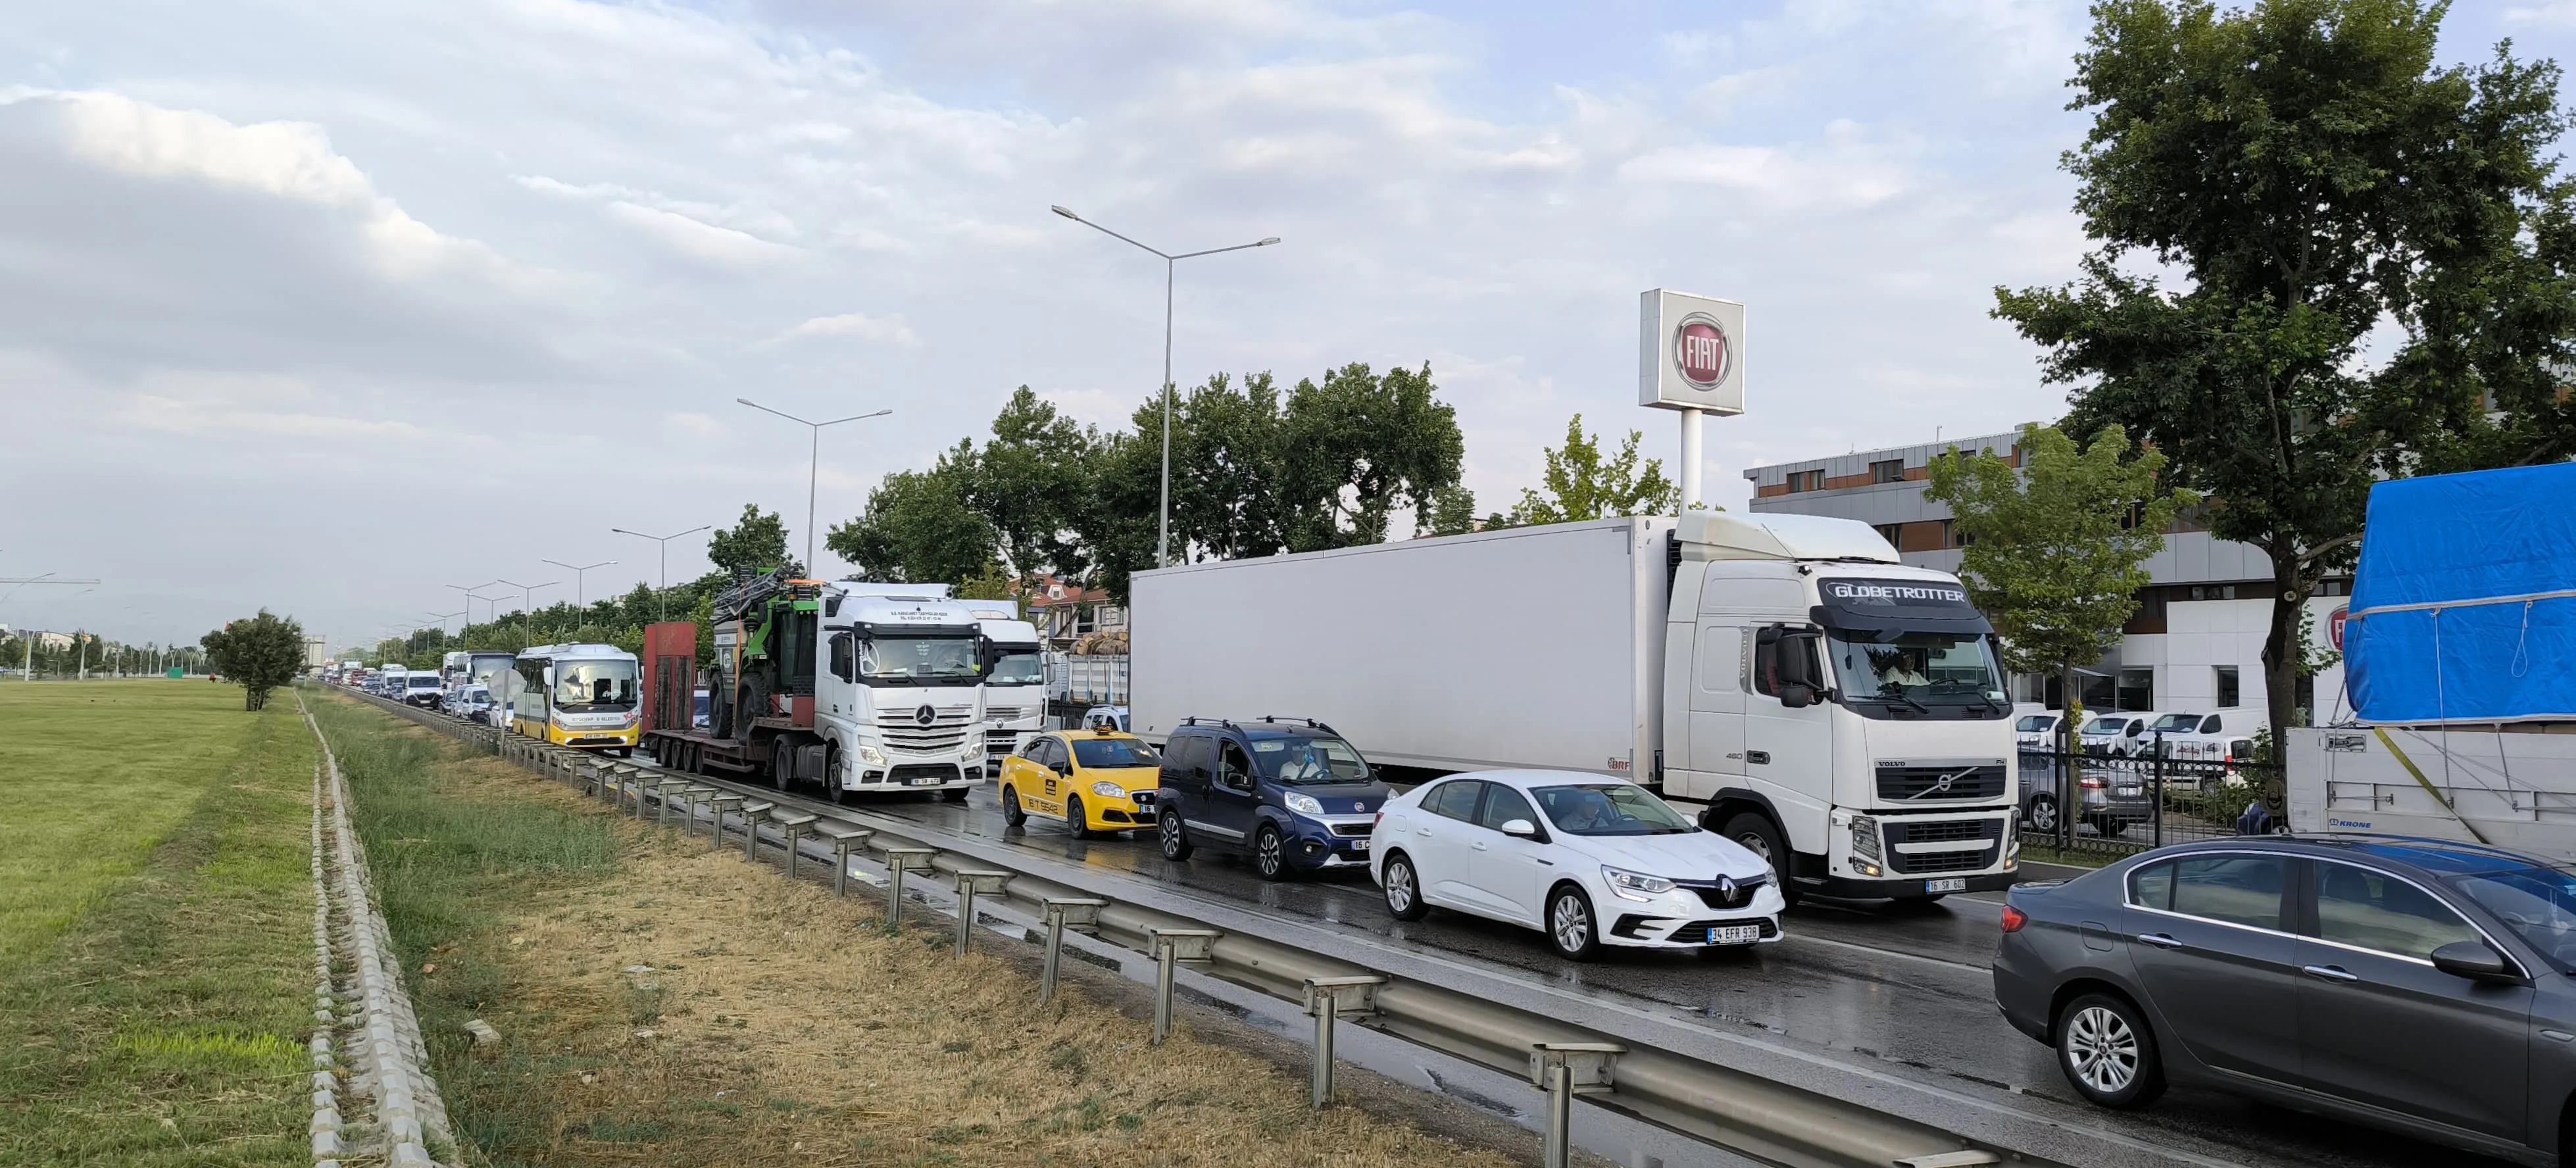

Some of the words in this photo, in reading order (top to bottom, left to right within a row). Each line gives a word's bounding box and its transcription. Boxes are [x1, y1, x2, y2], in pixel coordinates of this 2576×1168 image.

[1687, 335, 1719, 370] FIAT
[1835, 586, 1965, 602] GLOBETROTTER
[1931, 881, 1937, 890] 16
[1942, 881, 1949, 890] SR
[1954, 879, 1964, 888] 602
[1712, 929, 1721, 939] 34
[1725, 928, 1740, 939] EFR
[1743, 927, 1756, 938] 938
